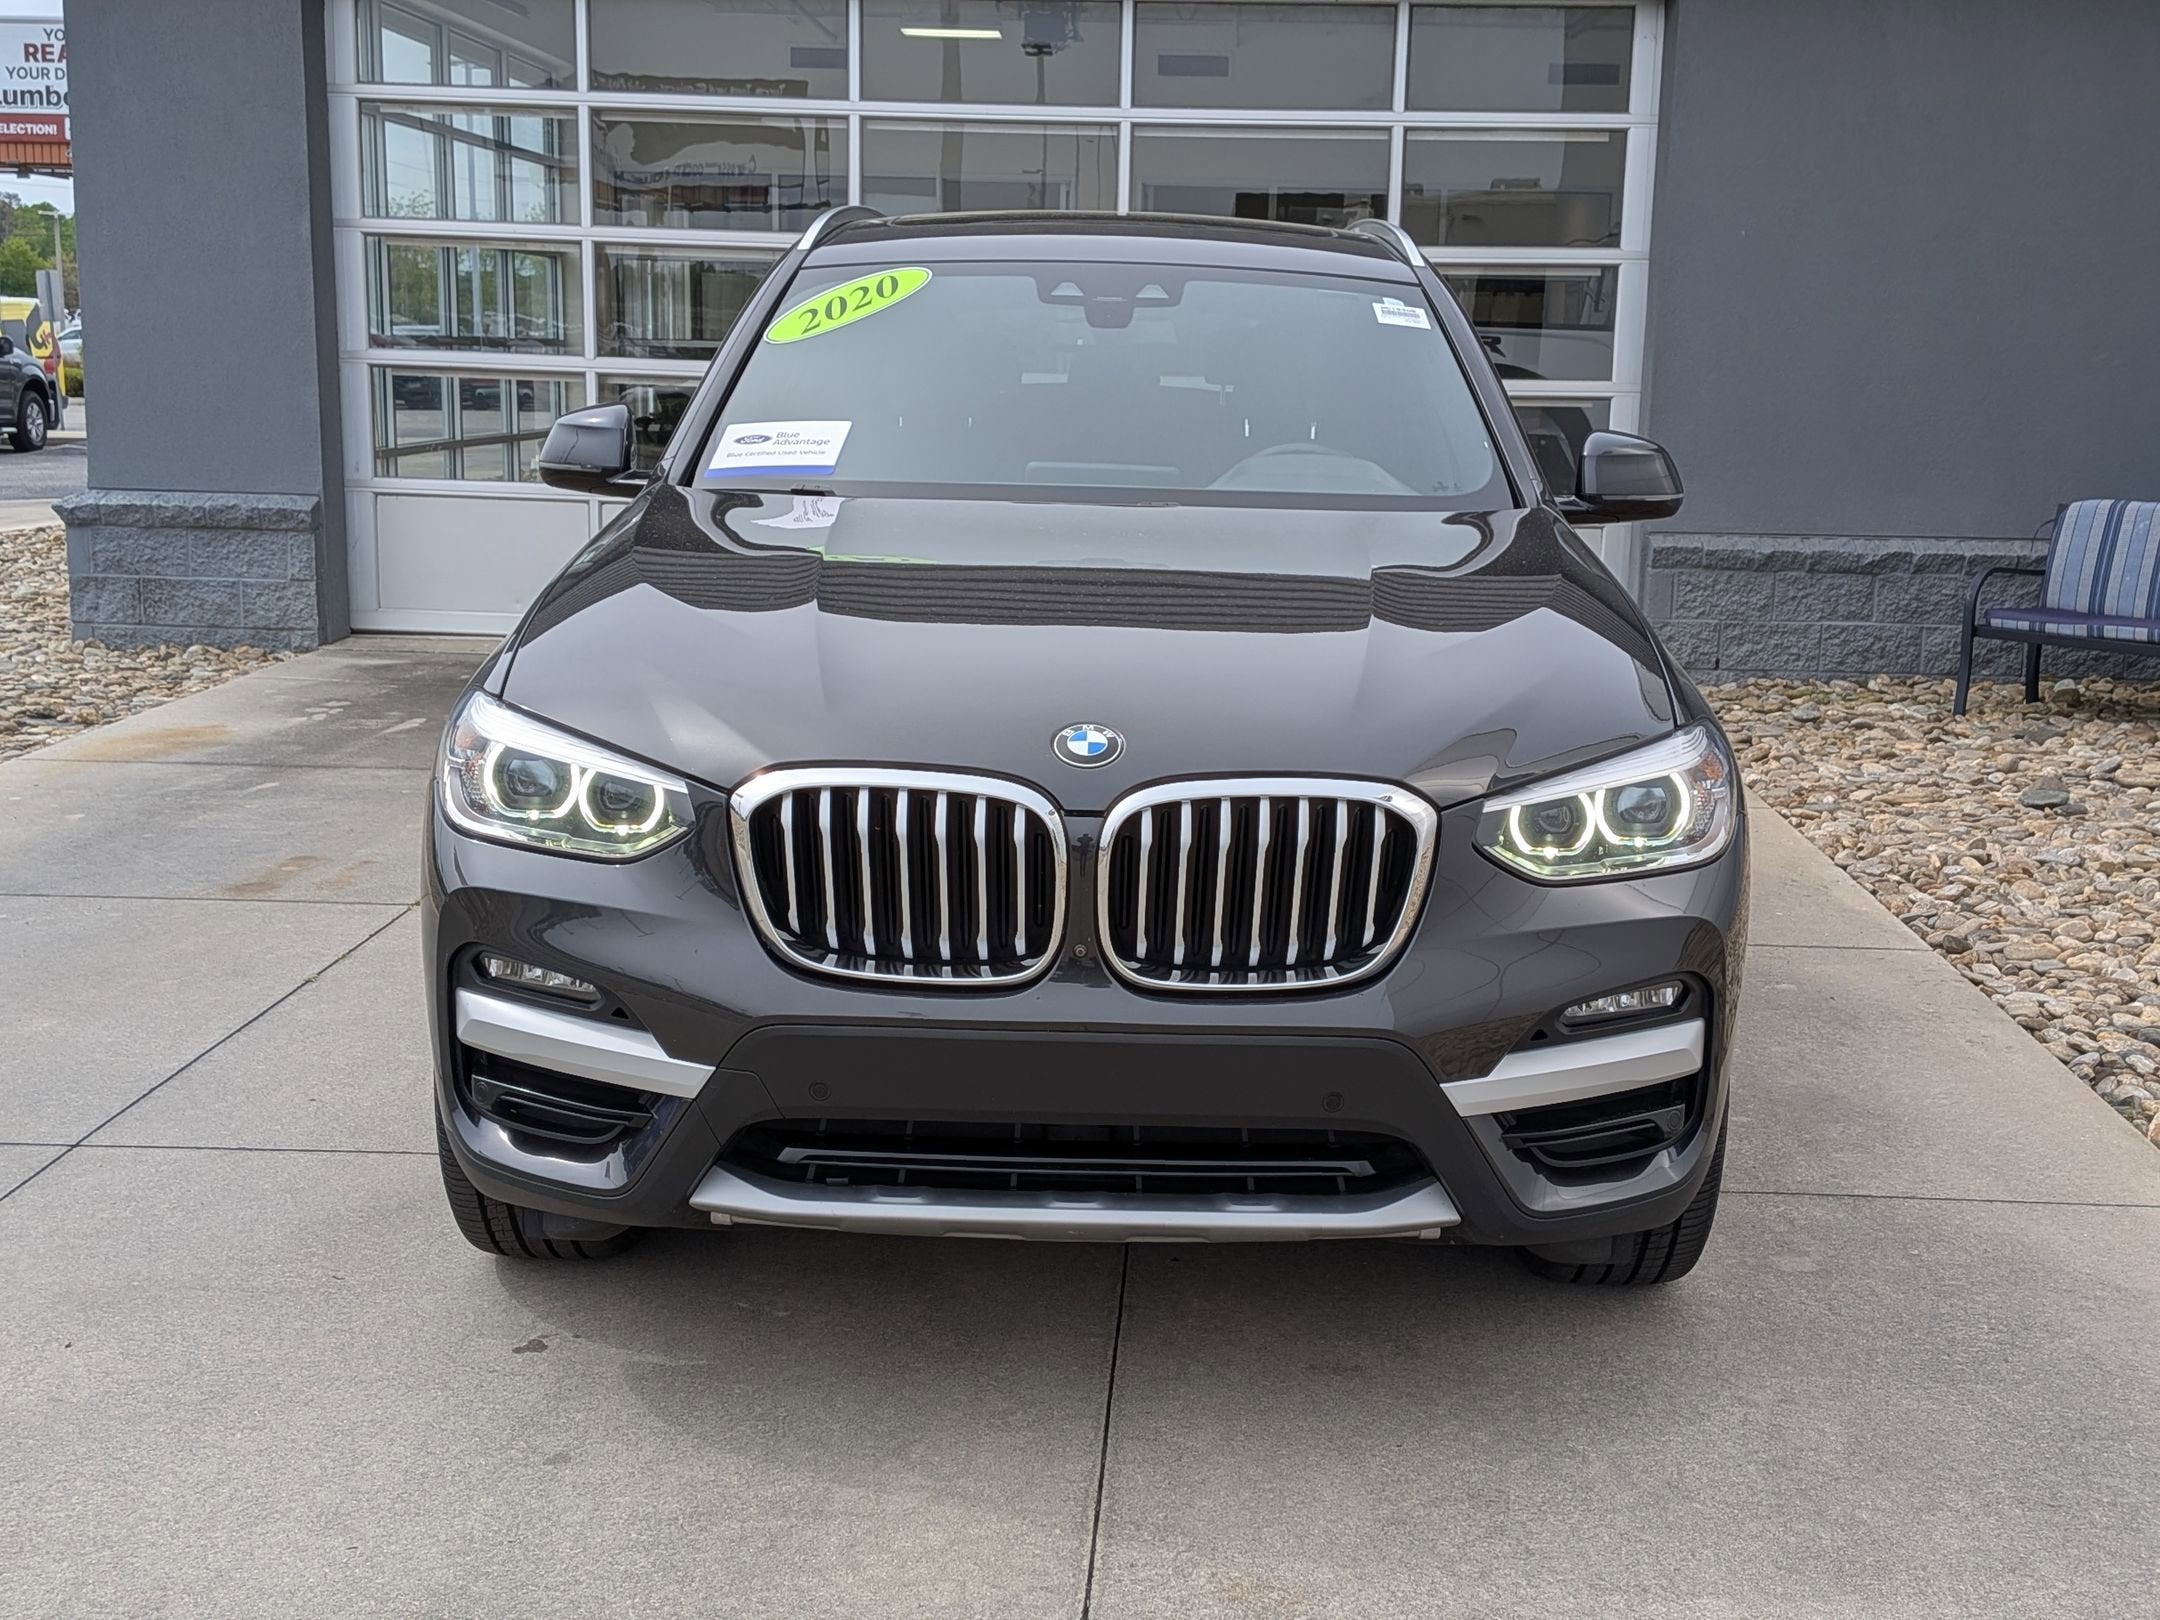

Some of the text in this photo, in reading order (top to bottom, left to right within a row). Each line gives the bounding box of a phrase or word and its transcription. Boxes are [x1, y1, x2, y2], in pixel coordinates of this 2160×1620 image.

[43, 28, 65, 41] YO
[5, 66, 65, 80] YOUR D
[0, 85, 69, 106] umb
[799, 275, 898, 335] 2020
[776, 431, 800, 439] Blue
[772, 439, 831, 447] Advantage
[1061, 724, 1115, 738] BMW
